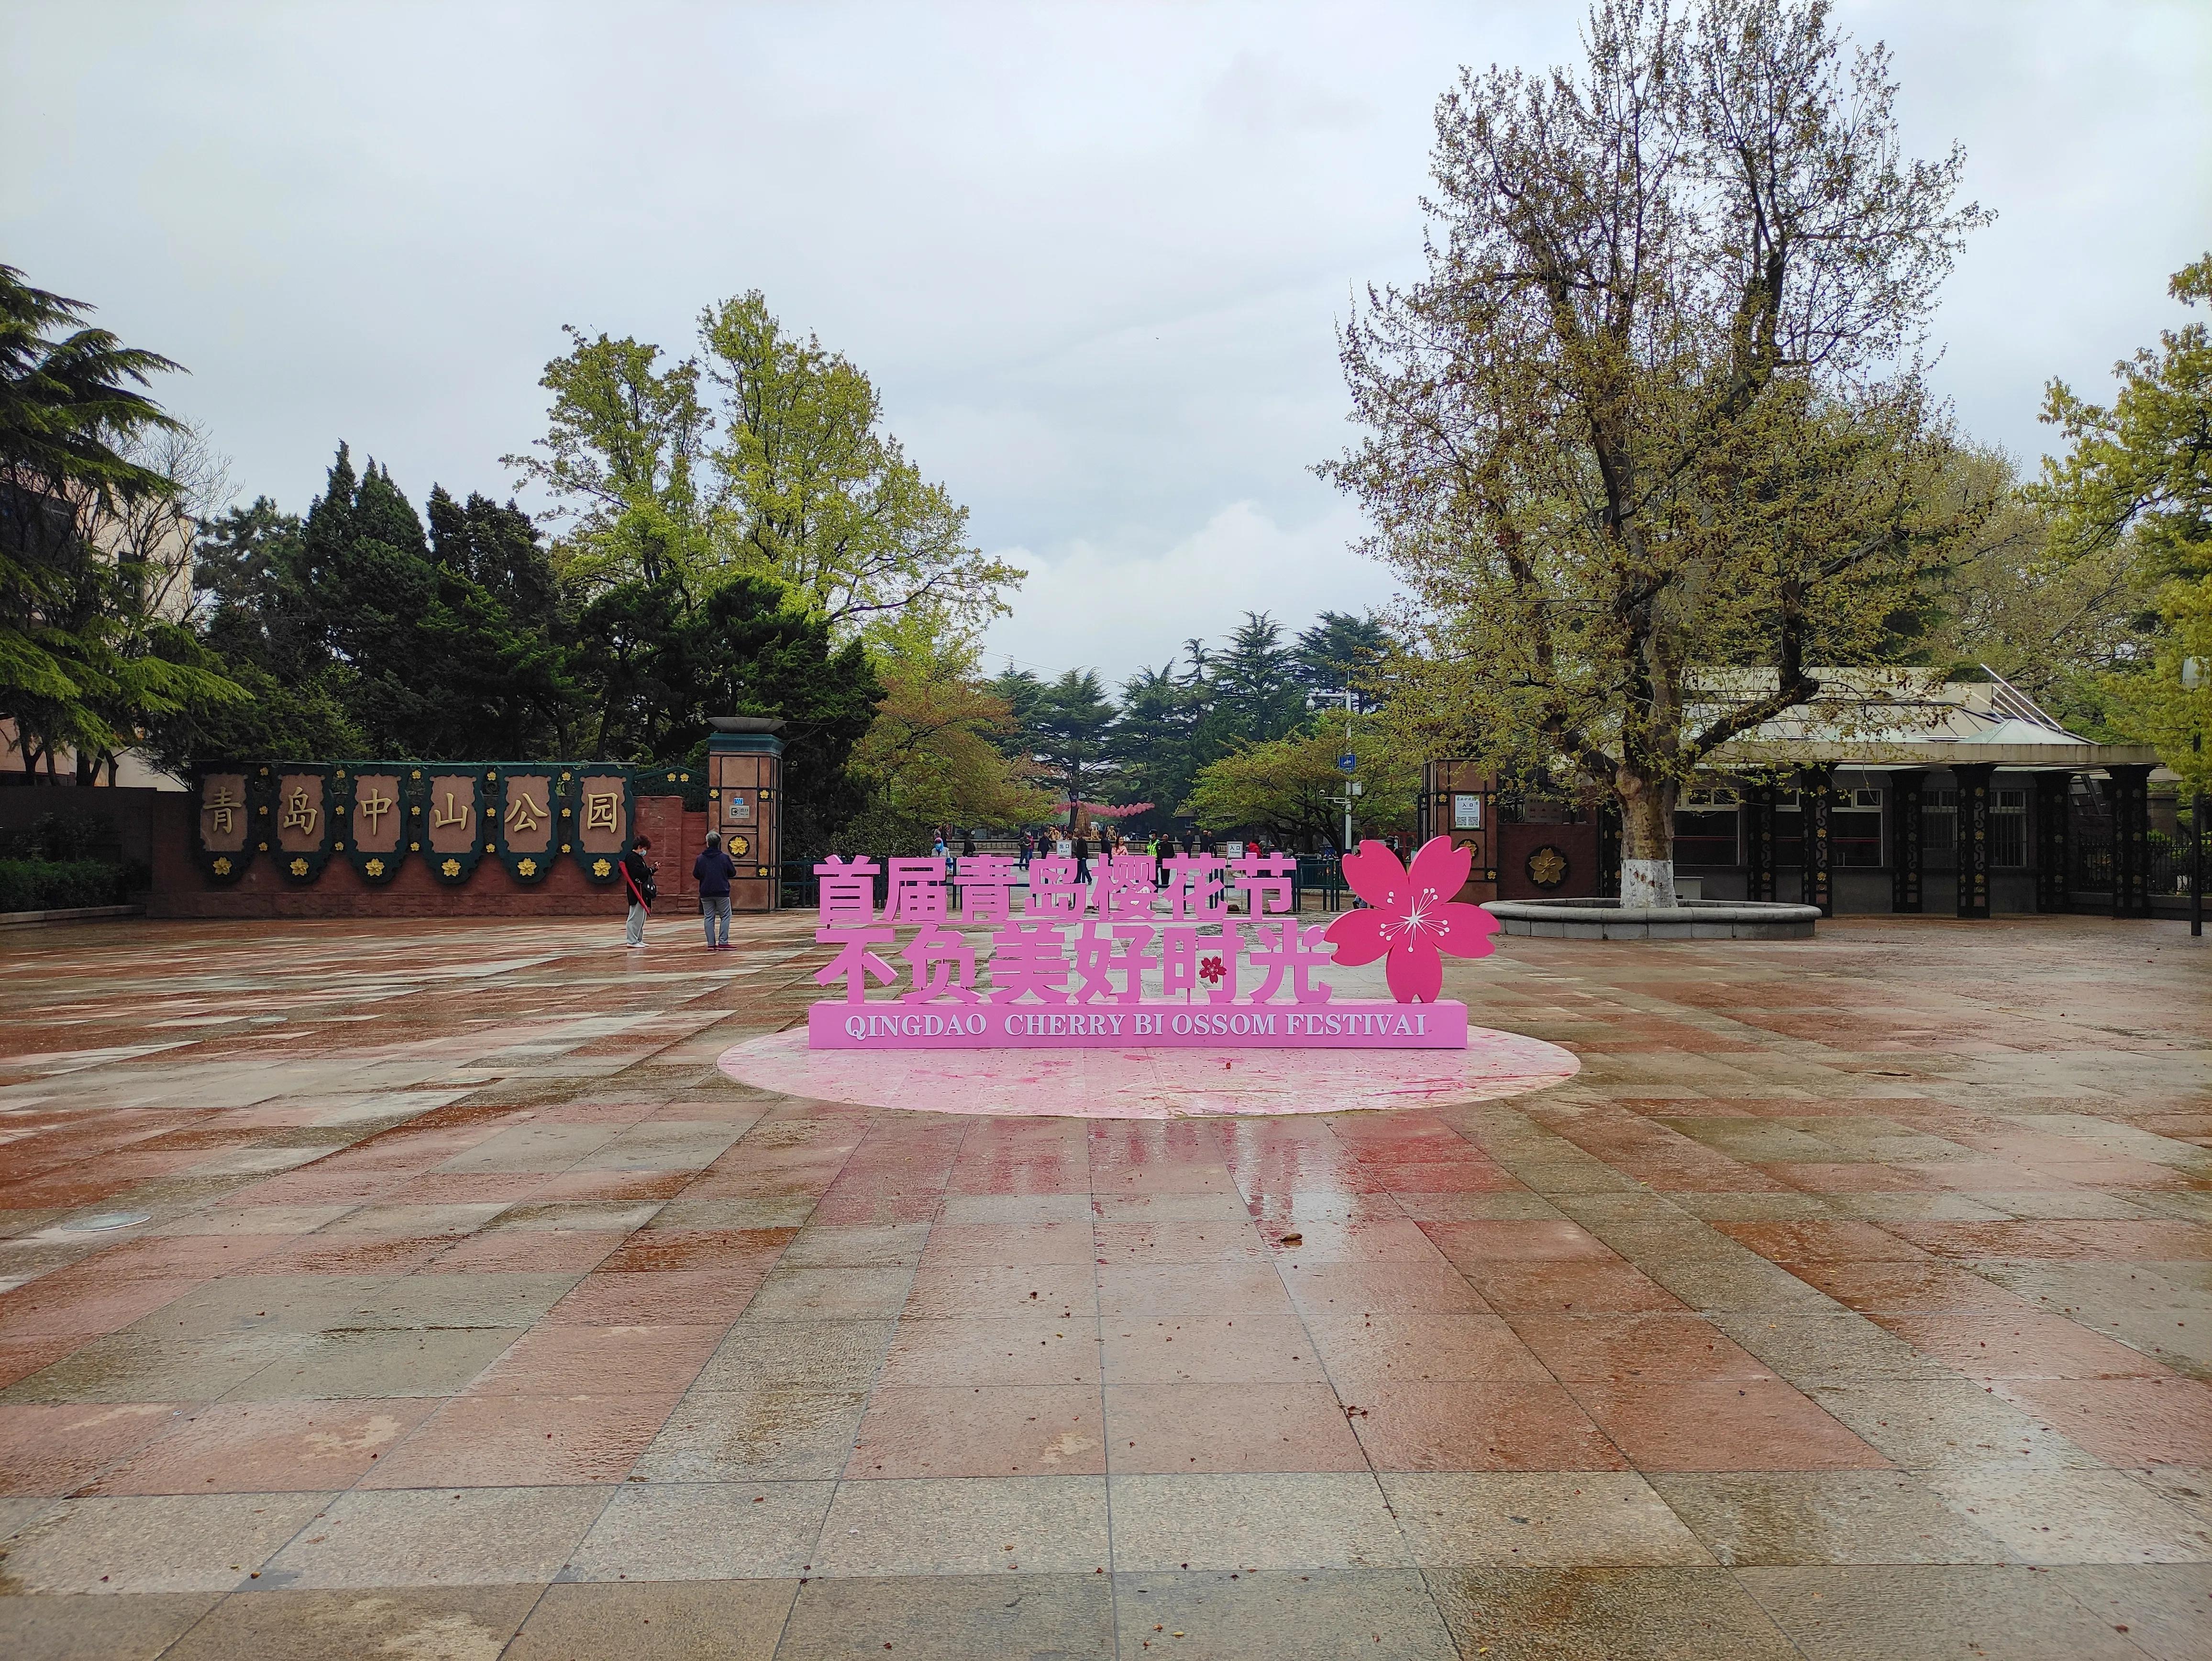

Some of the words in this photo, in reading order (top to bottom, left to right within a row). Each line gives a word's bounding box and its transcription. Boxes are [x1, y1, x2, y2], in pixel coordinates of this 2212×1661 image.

[203, 786, 619, 835] 青岛中山公园
[813, 853, 1296, 922] 首届青岛樱花节
[813, 922, 1332, 1004] 不负美好时光
[845, 1013, 986, 1040] QINGDAO
[1005, 1014, 1126, 1035] CHERRY
